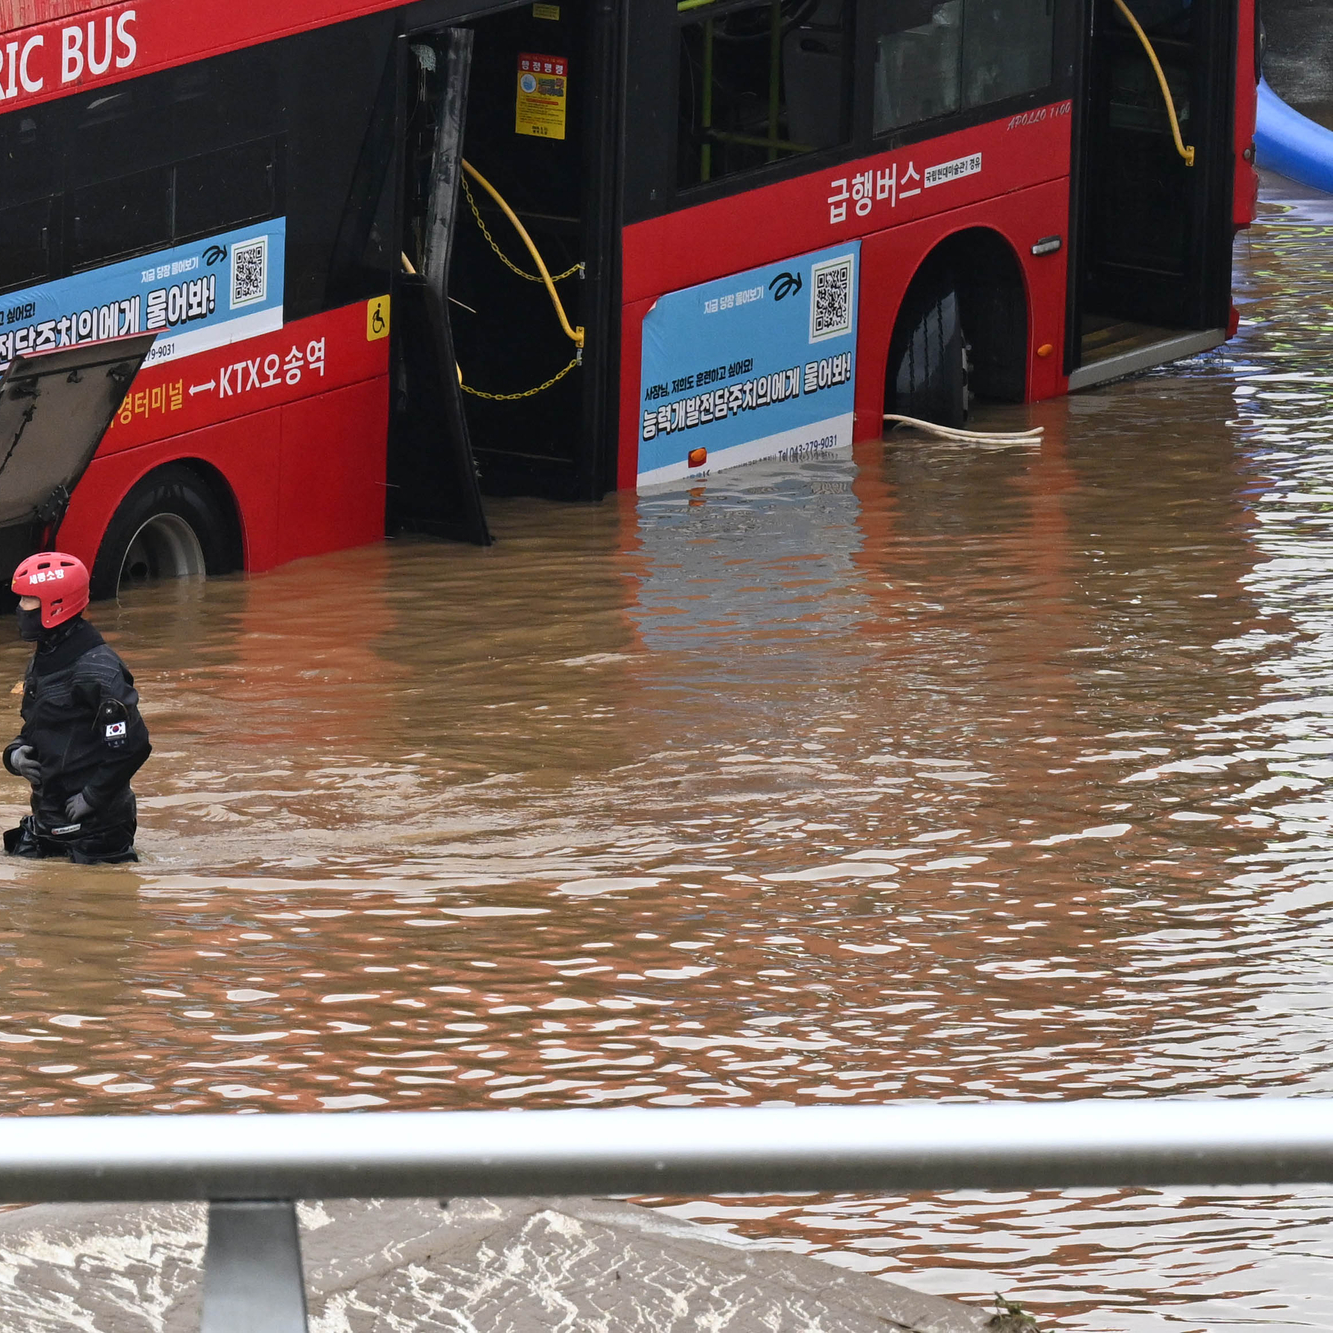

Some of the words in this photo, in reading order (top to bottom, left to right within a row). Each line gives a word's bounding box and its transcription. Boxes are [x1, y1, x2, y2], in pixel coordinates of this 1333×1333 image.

[61, 10, 138, 84] BUS
[1006, 113, 1047, 132] APOLLO
[1049, 103, 1071, 119] 1100
[827, 161, 922, 225] 급행버스
[141, 267, 155, 283] 지금
[171, 256, 199, 276] 물어보기
[6, 302, 36, 325] 싶어요!
[145, 273, 217, 330] 물어봐!
[704, 299, 719, 314] 지금
[735, 285, 765, 306] 물어보기
[110, 378, 184, 429] 경터미널
[219, 336, 326, 399] KTX오송역
[642, 365, 801, 442] 능력개발전담주치의에게
[803, 351, 853, 396] 물어봐!
[644, 381, 670, 402] 사장님,
[695, 365, 727, 388] 훈련하고
[778, 450, 789, 463] Tel
[29, 568, 65, 585] 세종소방
